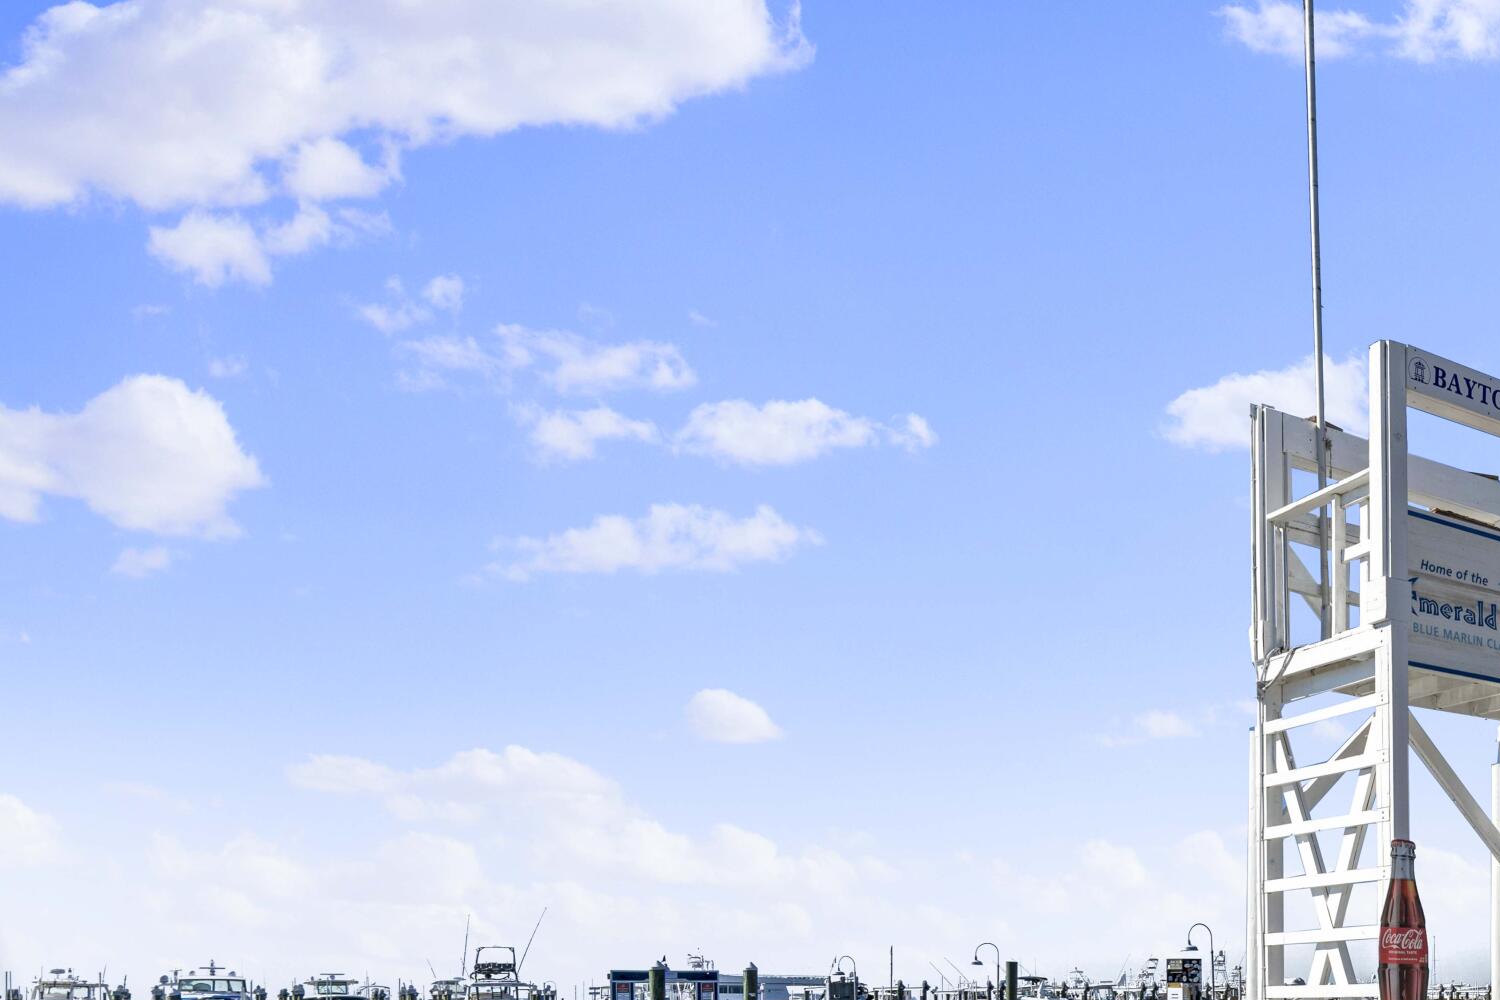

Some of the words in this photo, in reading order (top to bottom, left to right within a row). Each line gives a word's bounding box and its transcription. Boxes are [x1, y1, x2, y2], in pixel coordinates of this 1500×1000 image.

[1420, 559, 1453, 577] Home
[1456, 570, 1469, 581] of
[1471, 573, 1489, 586] the
[1412, 621, 1439, 637] BLUE
[1443, 628, 1483, 647] MARLIN
[1381, 928, 1423, 950] Coca-Cola
